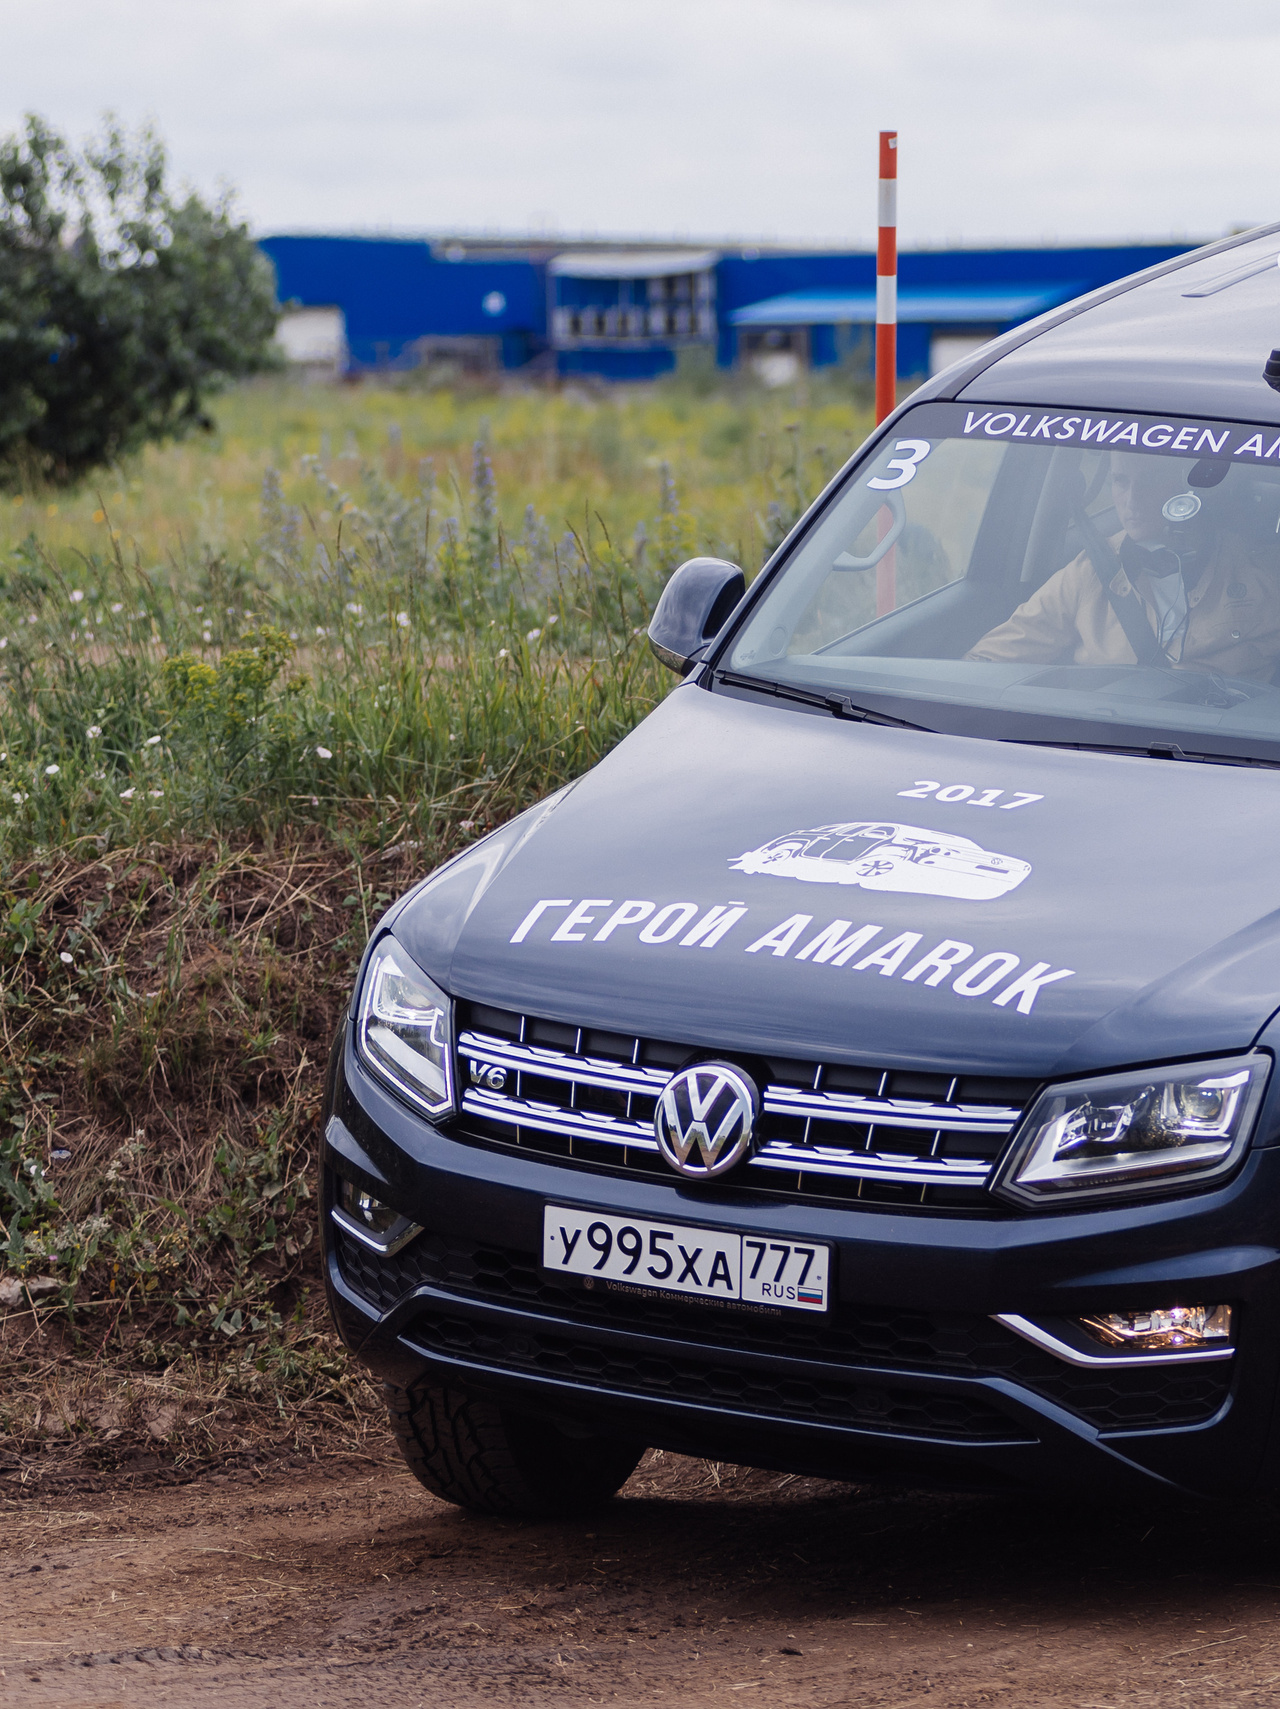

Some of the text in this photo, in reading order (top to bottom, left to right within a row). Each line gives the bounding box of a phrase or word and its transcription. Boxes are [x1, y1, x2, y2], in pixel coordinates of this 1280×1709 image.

[960, 411, 1231, 453] VOLKSWAGEN
[866, 439, 931, 490] 3
[897, 780, 1045, 810] 2017
[509, 899, 1076, 1016] ГЕРОЙ AMAROK
[469, 1060, 507, 1089] V6
[658, 1064, 754, 1174] VW
[746, 1241, 815, 1287] 777
[606, 1280, 658, 1299] Volkswagen
[659, 1289, 725, 1310] Коммерческие
[761, 1283, 796, 1301] RUS
